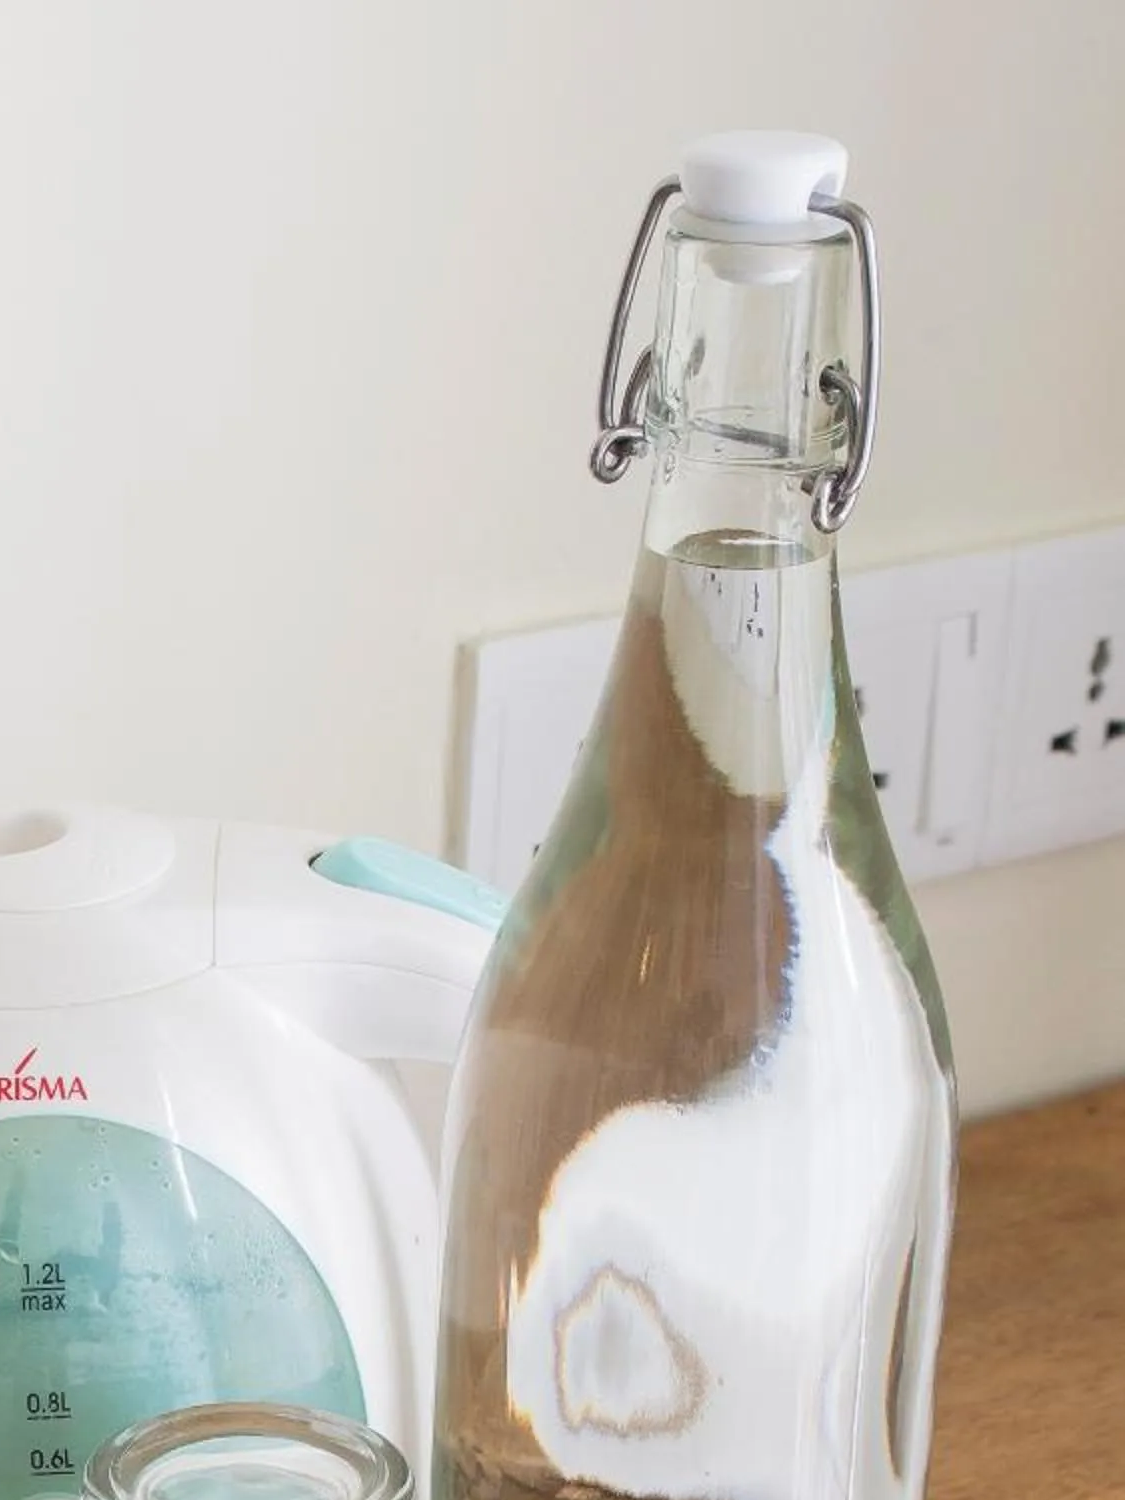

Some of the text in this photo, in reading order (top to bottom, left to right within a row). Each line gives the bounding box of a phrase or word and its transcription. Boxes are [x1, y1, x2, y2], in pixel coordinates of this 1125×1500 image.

[22, 1262, 66, 1285] 1.2L
[22, 1294, 66, 1312] max
[26, 1391, 72, 1414] 0.8L
[30, 1447, 75, 1470] 0.6L
